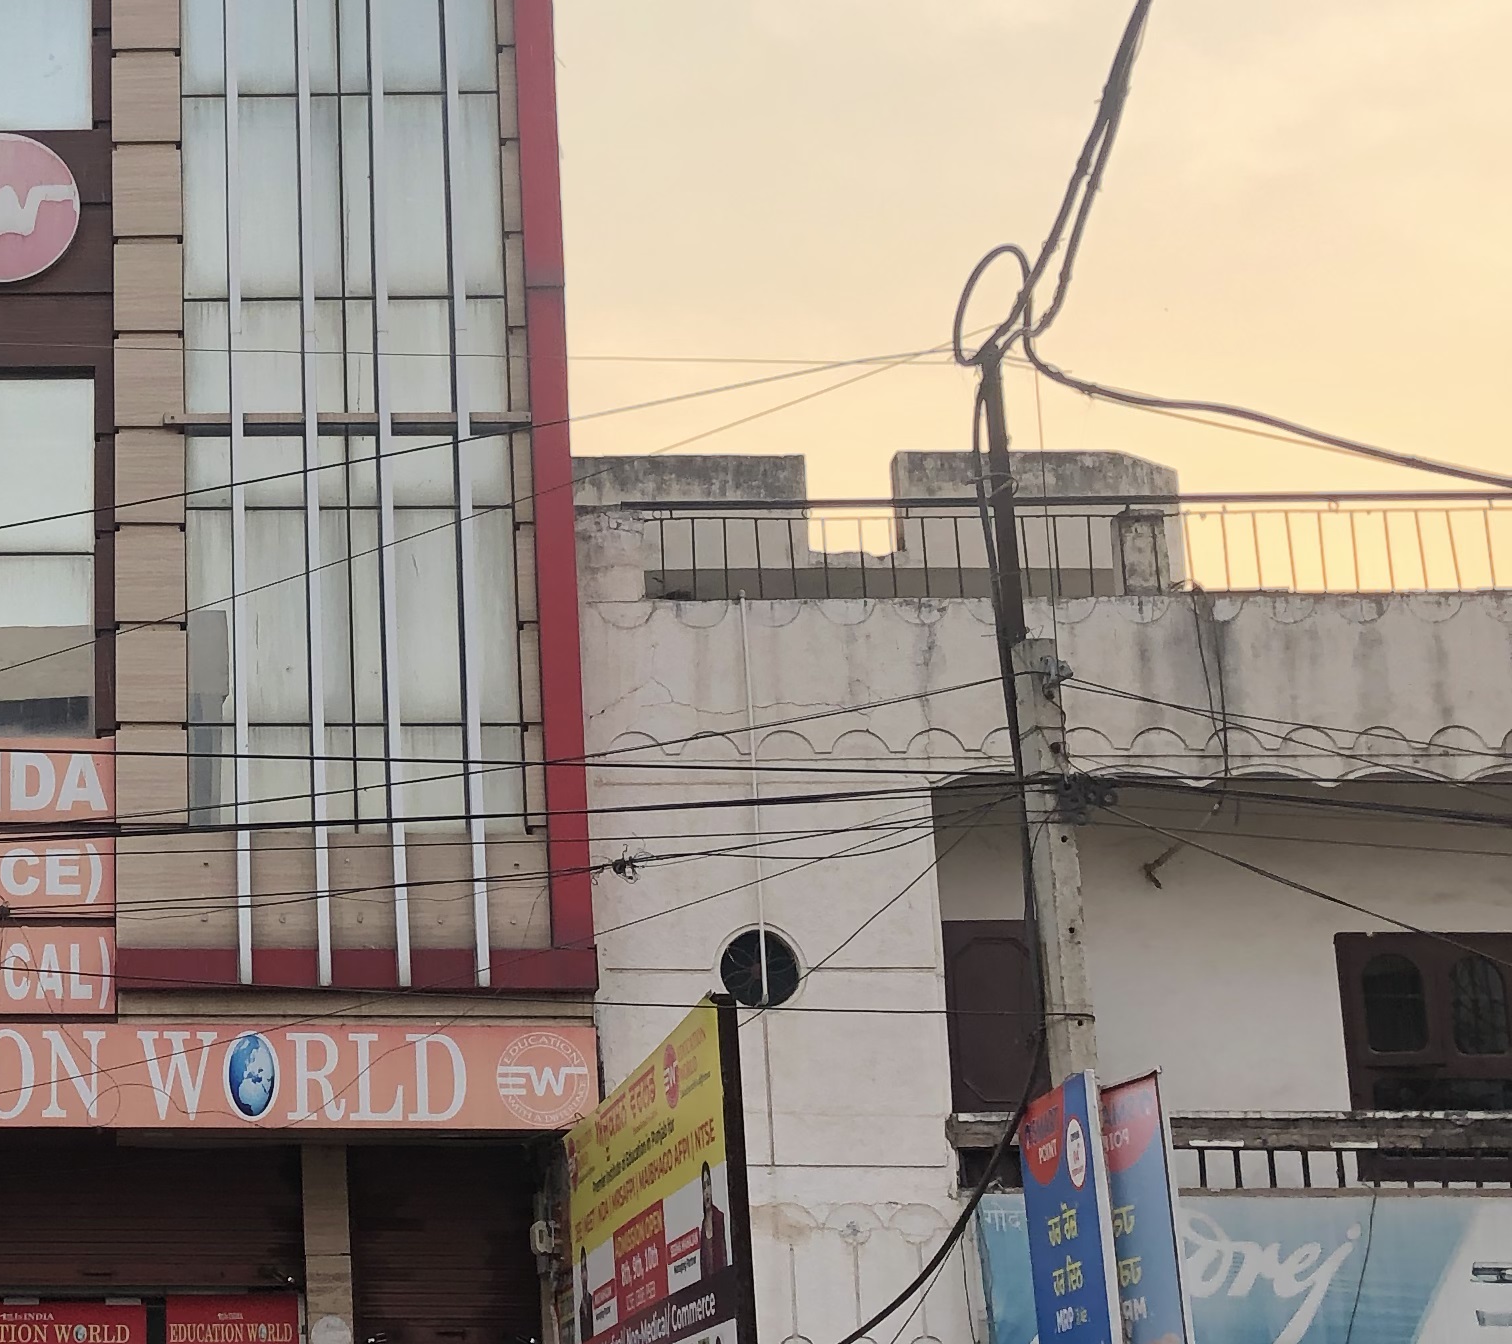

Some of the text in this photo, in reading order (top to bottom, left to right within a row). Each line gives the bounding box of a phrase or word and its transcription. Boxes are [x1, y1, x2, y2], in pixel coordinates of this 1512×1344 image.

[137, 1029, 467, 1122] WORLD
[1039, 1138, 1057, 1165] POINT
[54, 1323, 130, 1344] WORLD
[169, 1323, 293, 1343] EDUCATION WORLD
